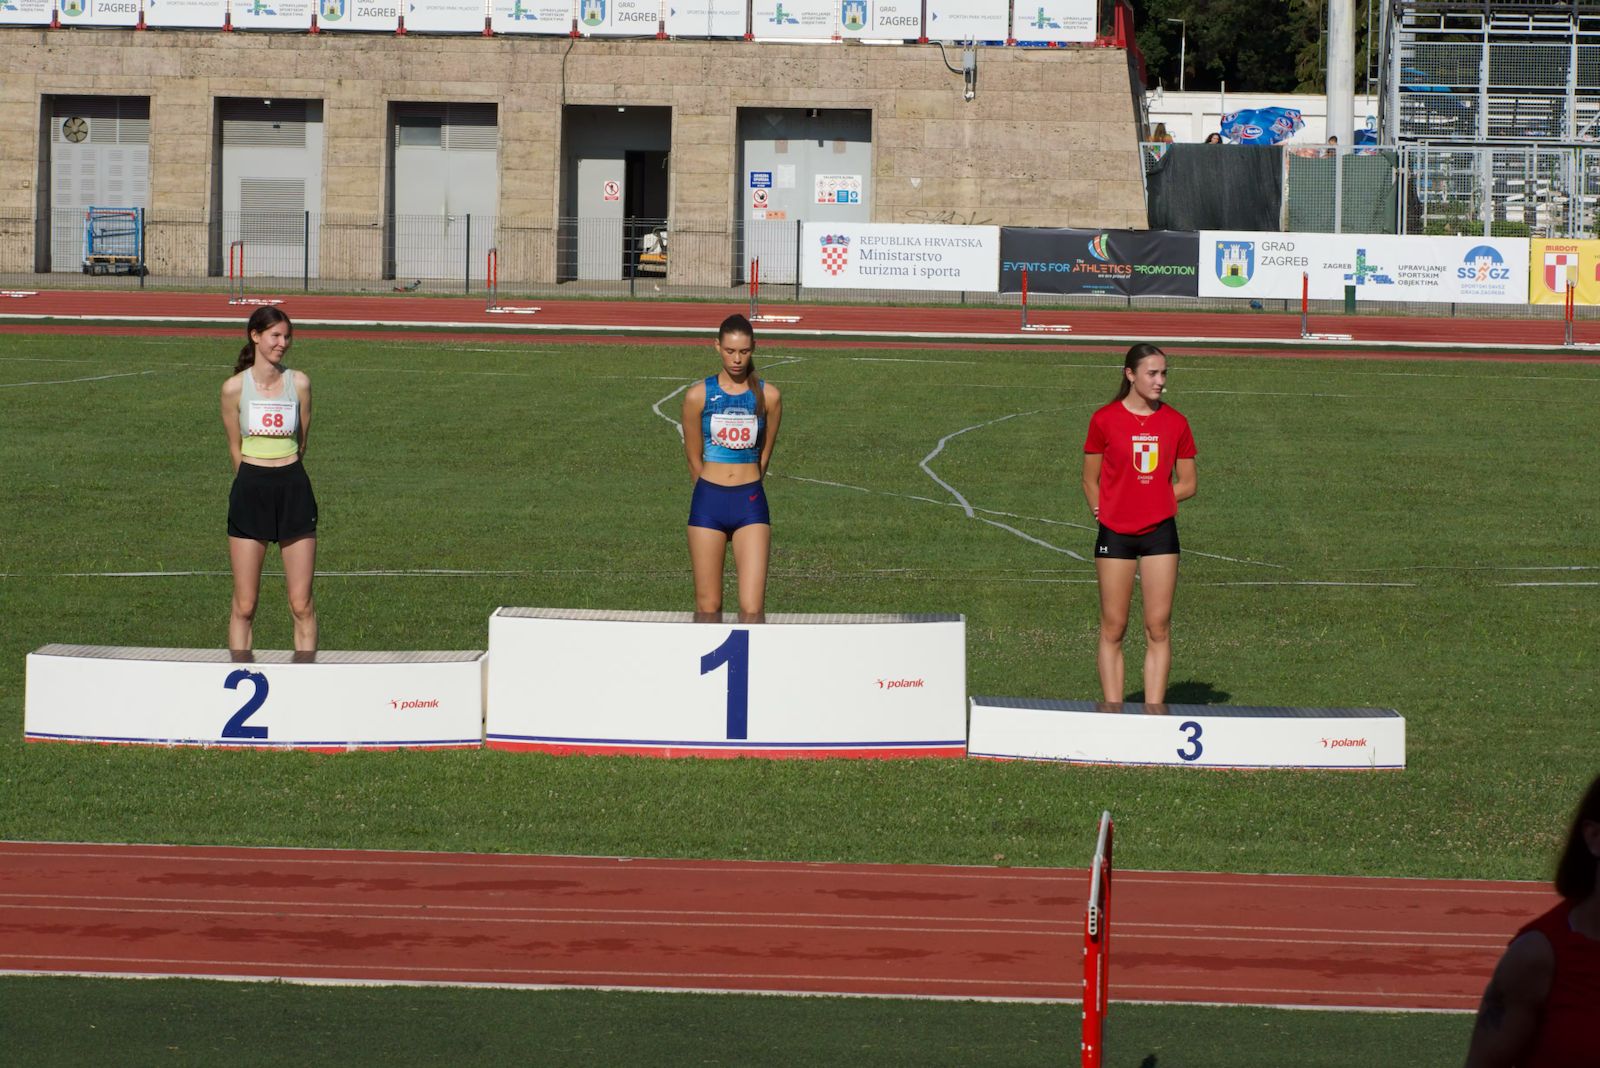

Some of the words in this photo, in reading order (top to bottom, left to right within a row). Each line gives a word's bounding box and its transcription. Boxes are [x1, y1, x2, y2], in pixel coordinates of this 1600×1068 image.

[98, 3, 137, 13] ZAGREB
[357, 8, 396, 17] ZAGREB
[618, 12, 657, 21] ZAGREB
[879, 16, 919, 26] ZAGREB
[860, 235, 922, 247] REPUBLIKA
[924, 237, 983, 248] HRVATSKA
[1261, 241, 1295, 252] GRAD
[859, 249, 943, 262] Ministarstvo
[1261, 256, 1309, 267] ZAGREB
[859, 265, 909, 277] turizma
[913, 265, 917, 276] i
[920, 267, 961, 279] sporta
[1003, 262, 1047, 272] EVENTS
[1049, 262, 1071, 273] FOR
[1072, 263, 1132, 273] ATHLETICS
[1134, 265, 1195, 276] PROMOTION
[262, 412, 284, 428] 68
[717, 427, 751, 442] 408
[700, 629, 749, 739] 1
[886, 678, 925, 689] polanik
[221, 668, 269, 739] 2
[401, 699, 439, 710] polanik
[1176, 721, 1203, 761] 3
[1331, 737, 1368, 748] polanik
